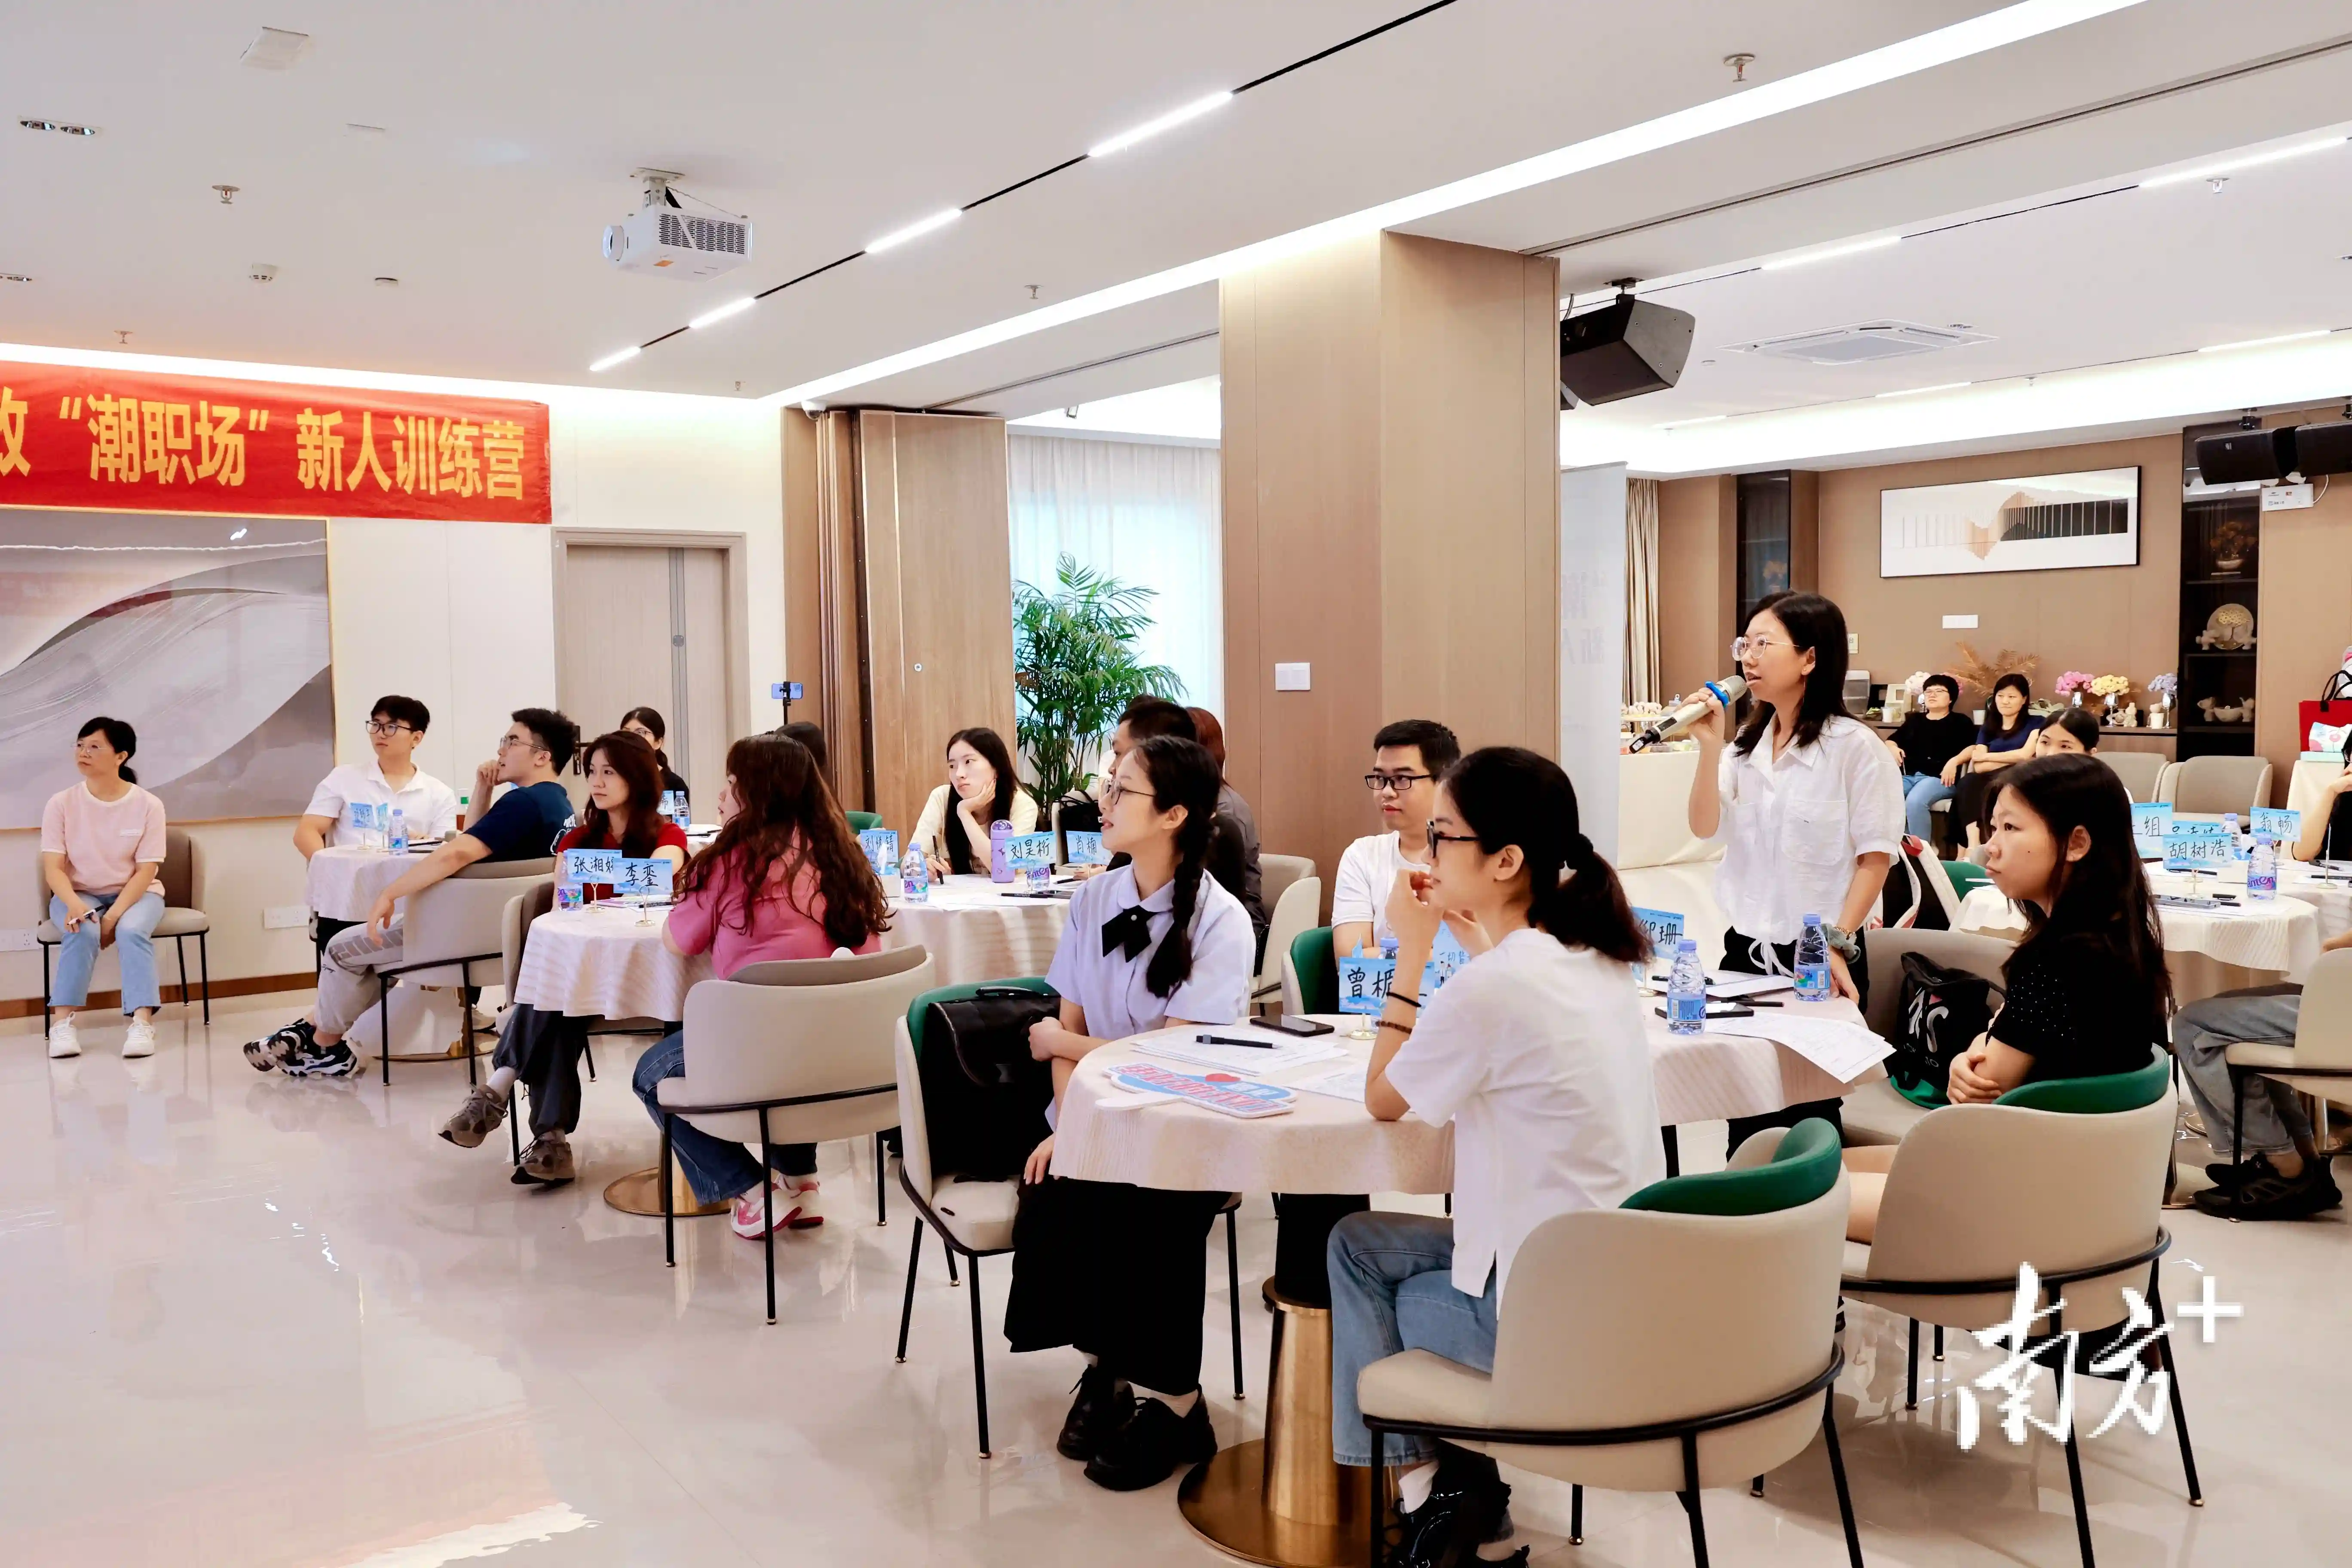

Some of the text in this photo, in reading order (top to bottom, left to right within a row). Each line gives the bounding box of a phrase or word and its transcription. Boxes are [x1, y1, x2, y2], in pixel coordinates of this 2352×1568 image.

[2260, 812, 2292, 835] 翁畅
[1076, 835, 1097, 855] 肖楠
[2169, 839, 2226, 860] 胡树浩
[1439, 950, 1471, 965] 一切皆
